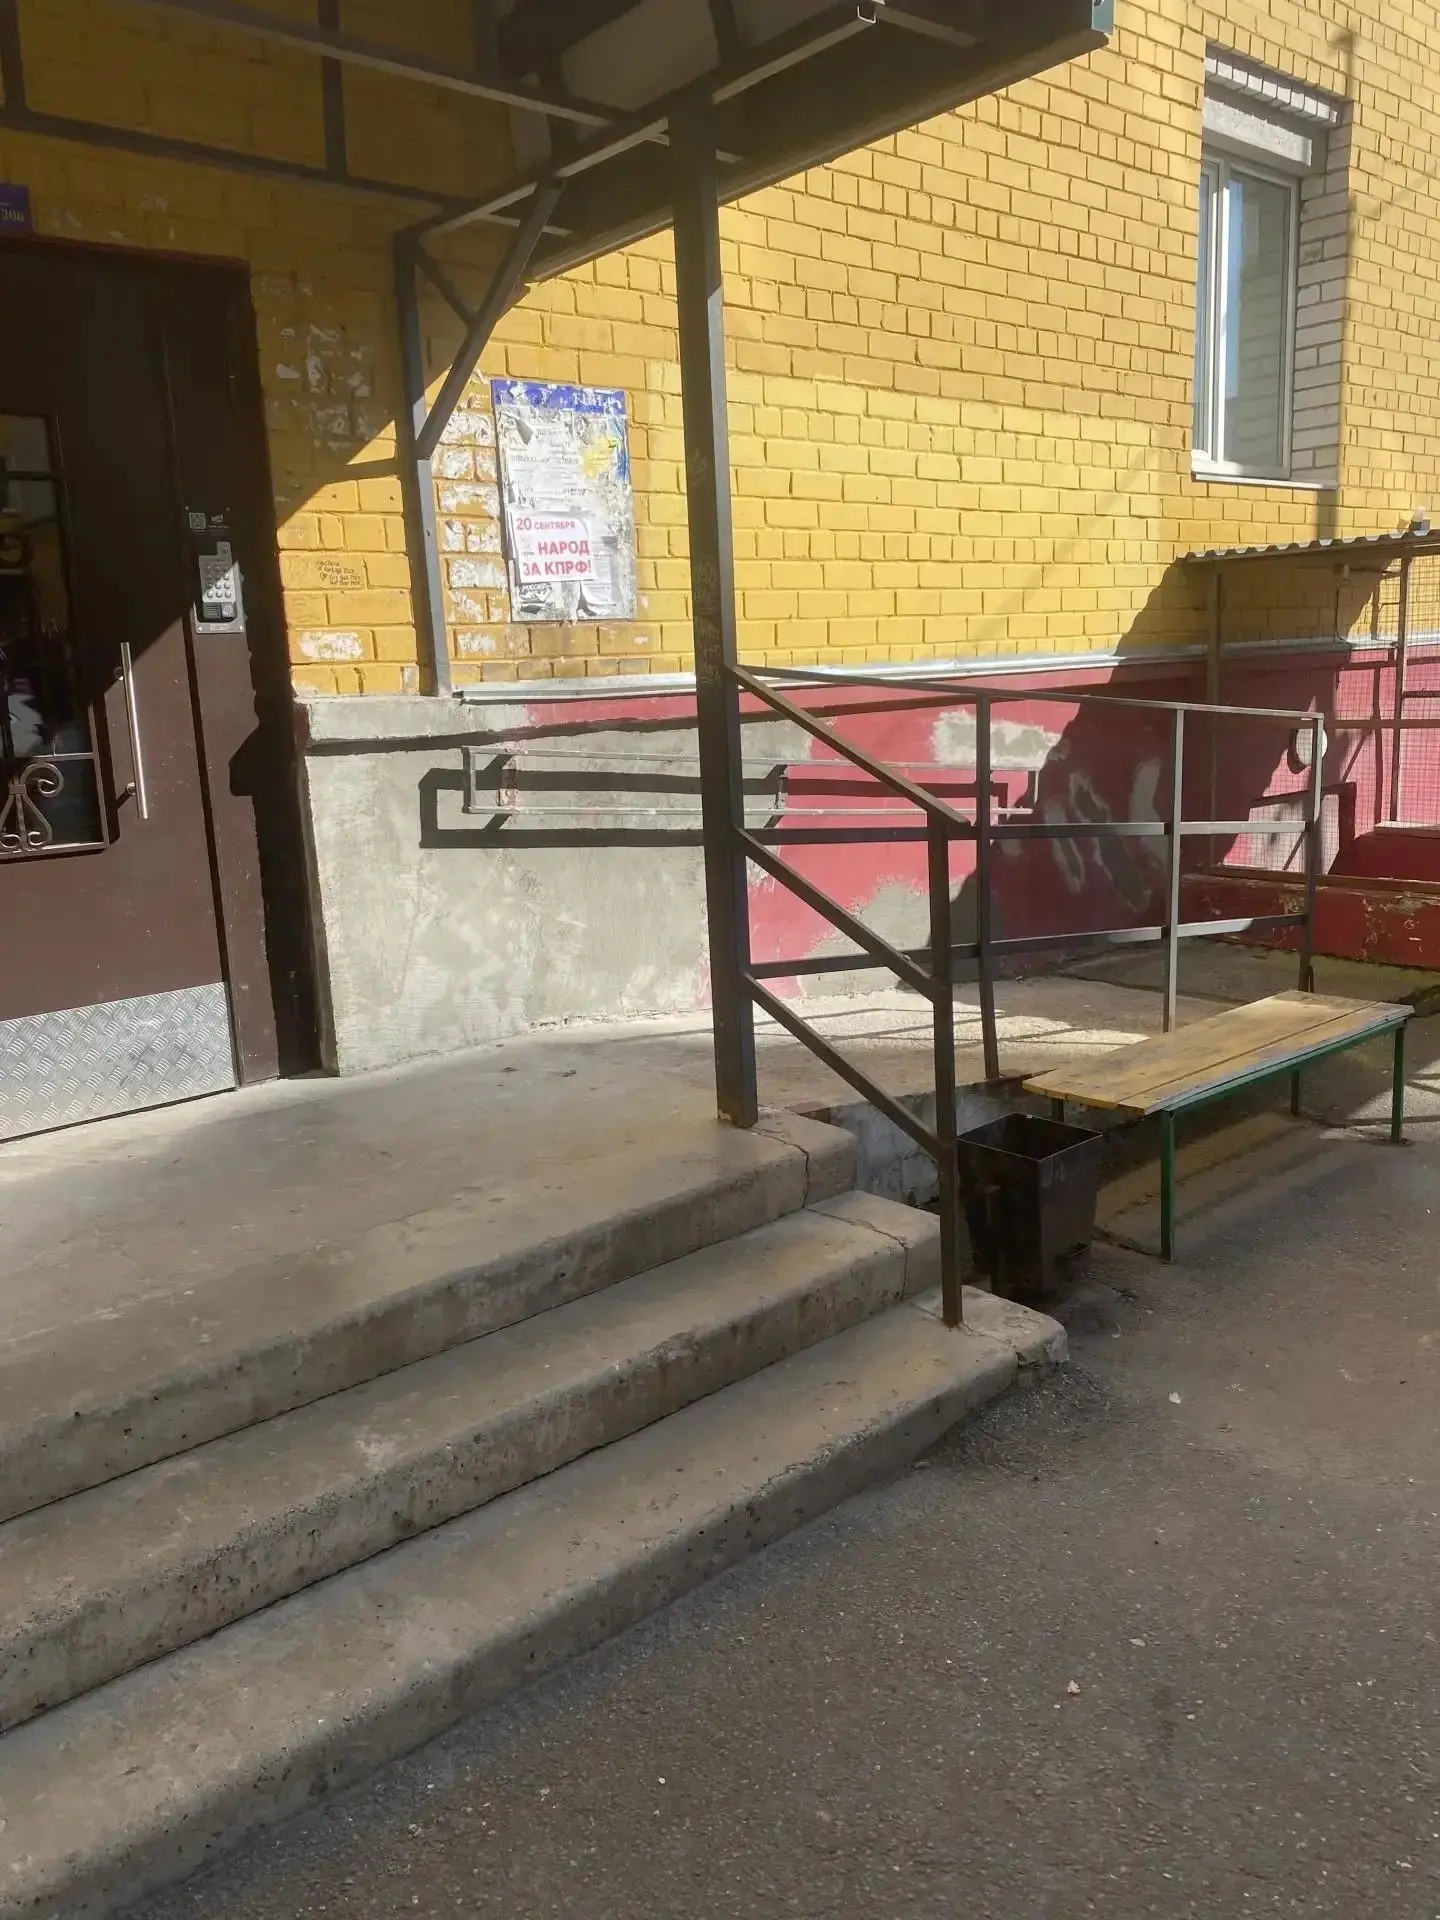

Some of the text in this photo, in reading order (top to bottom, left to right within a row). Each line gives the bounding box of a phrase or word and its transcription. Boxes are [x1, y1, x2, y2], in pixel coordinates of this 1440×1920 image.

[516, 517, 576, 530] 20 СЕНТЯБРЯ
[538, 540, 590, 556] НАРОД
[522, 560, 592, 576] ЗА КПРФ!
